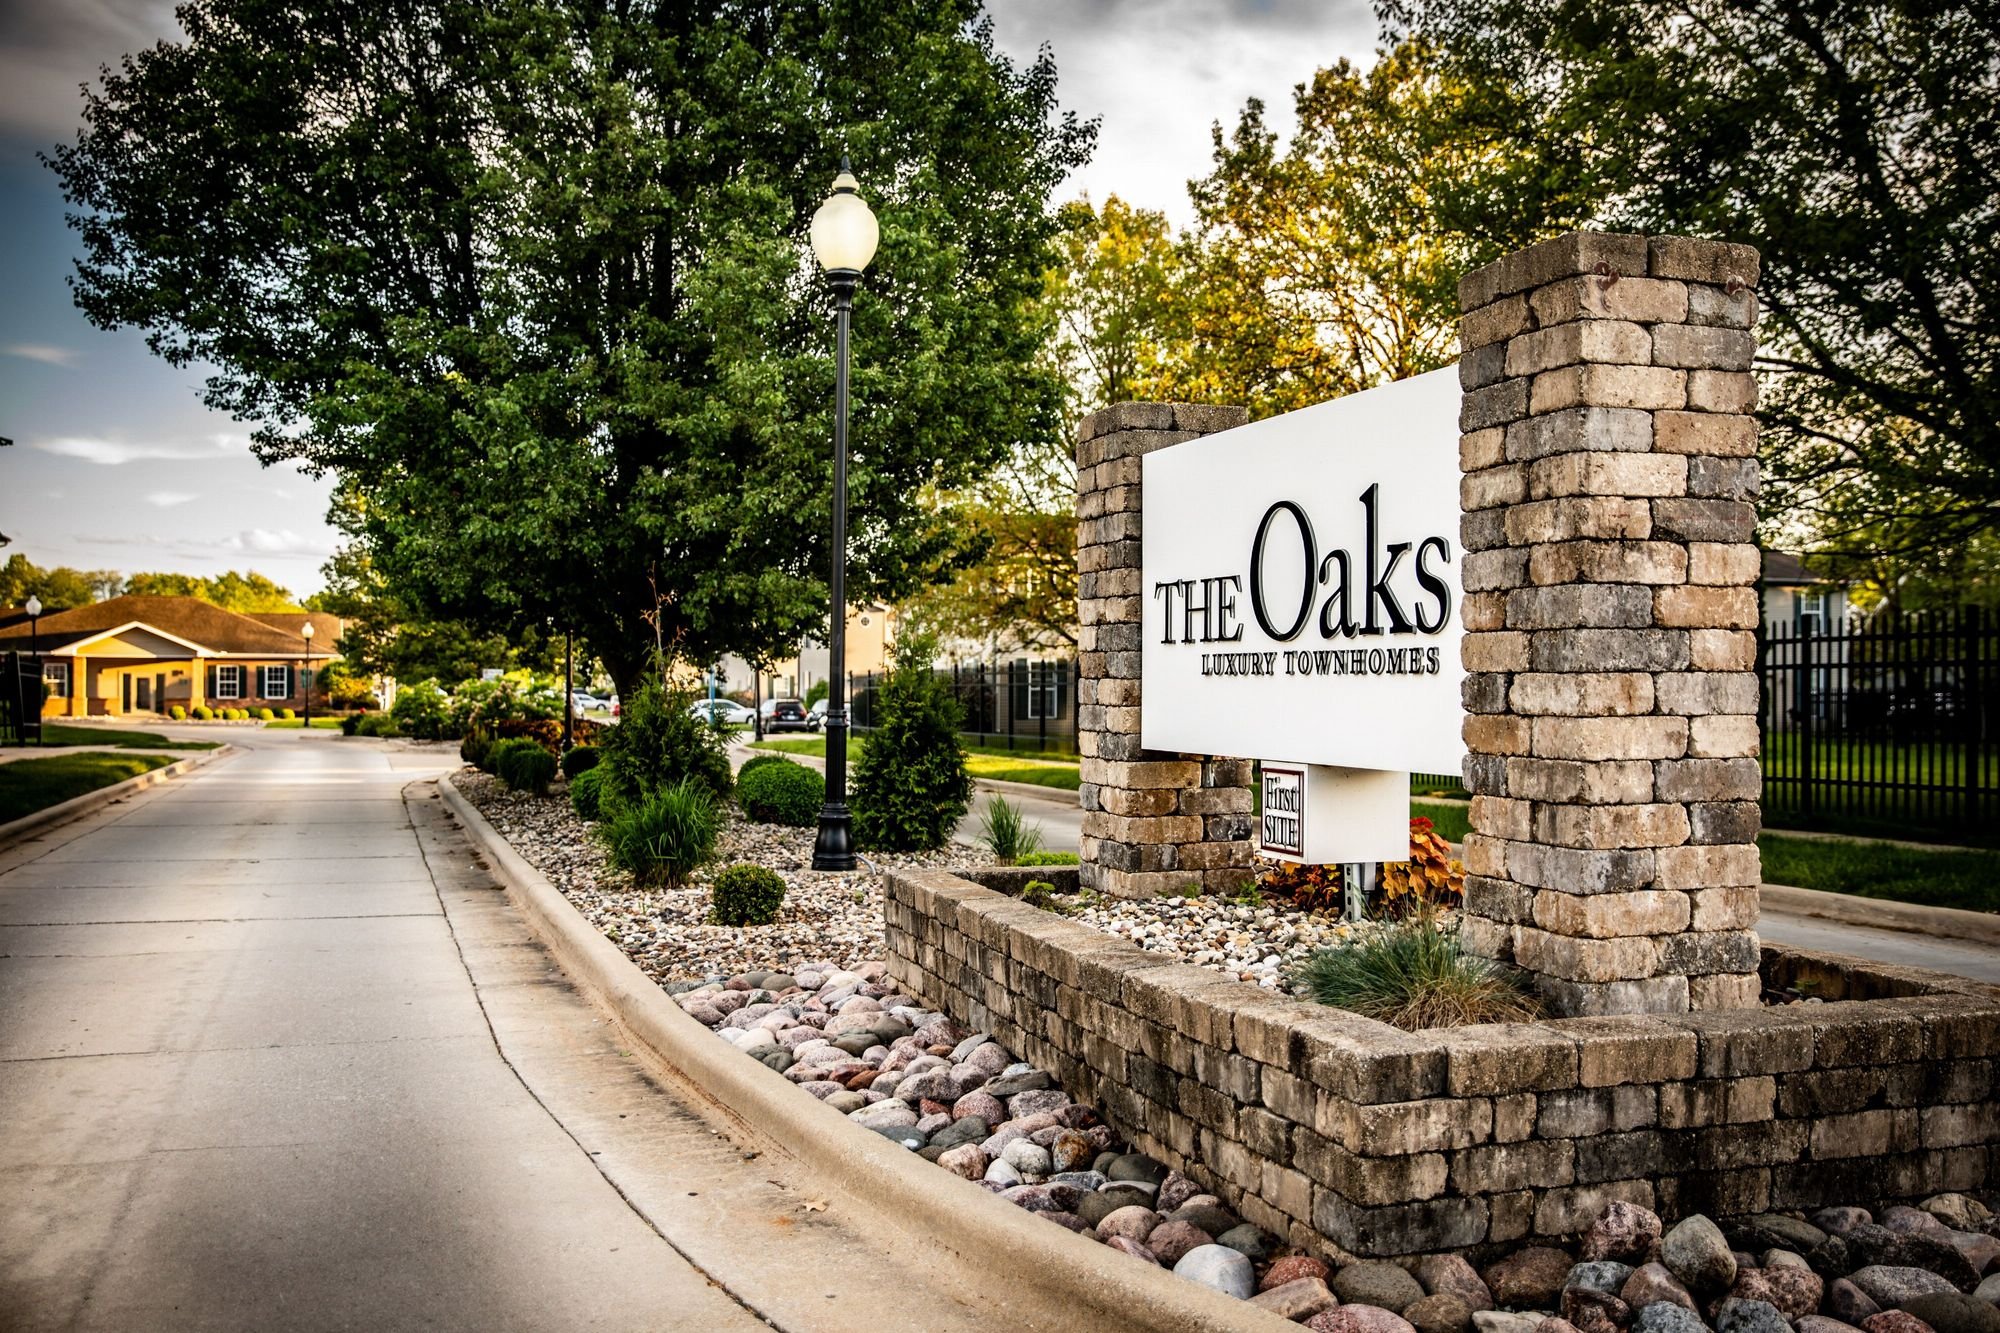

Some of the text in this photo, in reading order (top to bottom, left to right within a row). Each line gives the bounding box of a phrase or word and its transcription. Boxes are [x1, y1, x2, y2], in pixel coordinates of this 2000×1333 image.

[1153, 482, 1452, 646] THE Oaks
[1201, 647, 1440, 677] LUXURY TOWNHOMES
[1265, 776, 1299, 812] First
[1264, 814, 1298, 848] SITE
